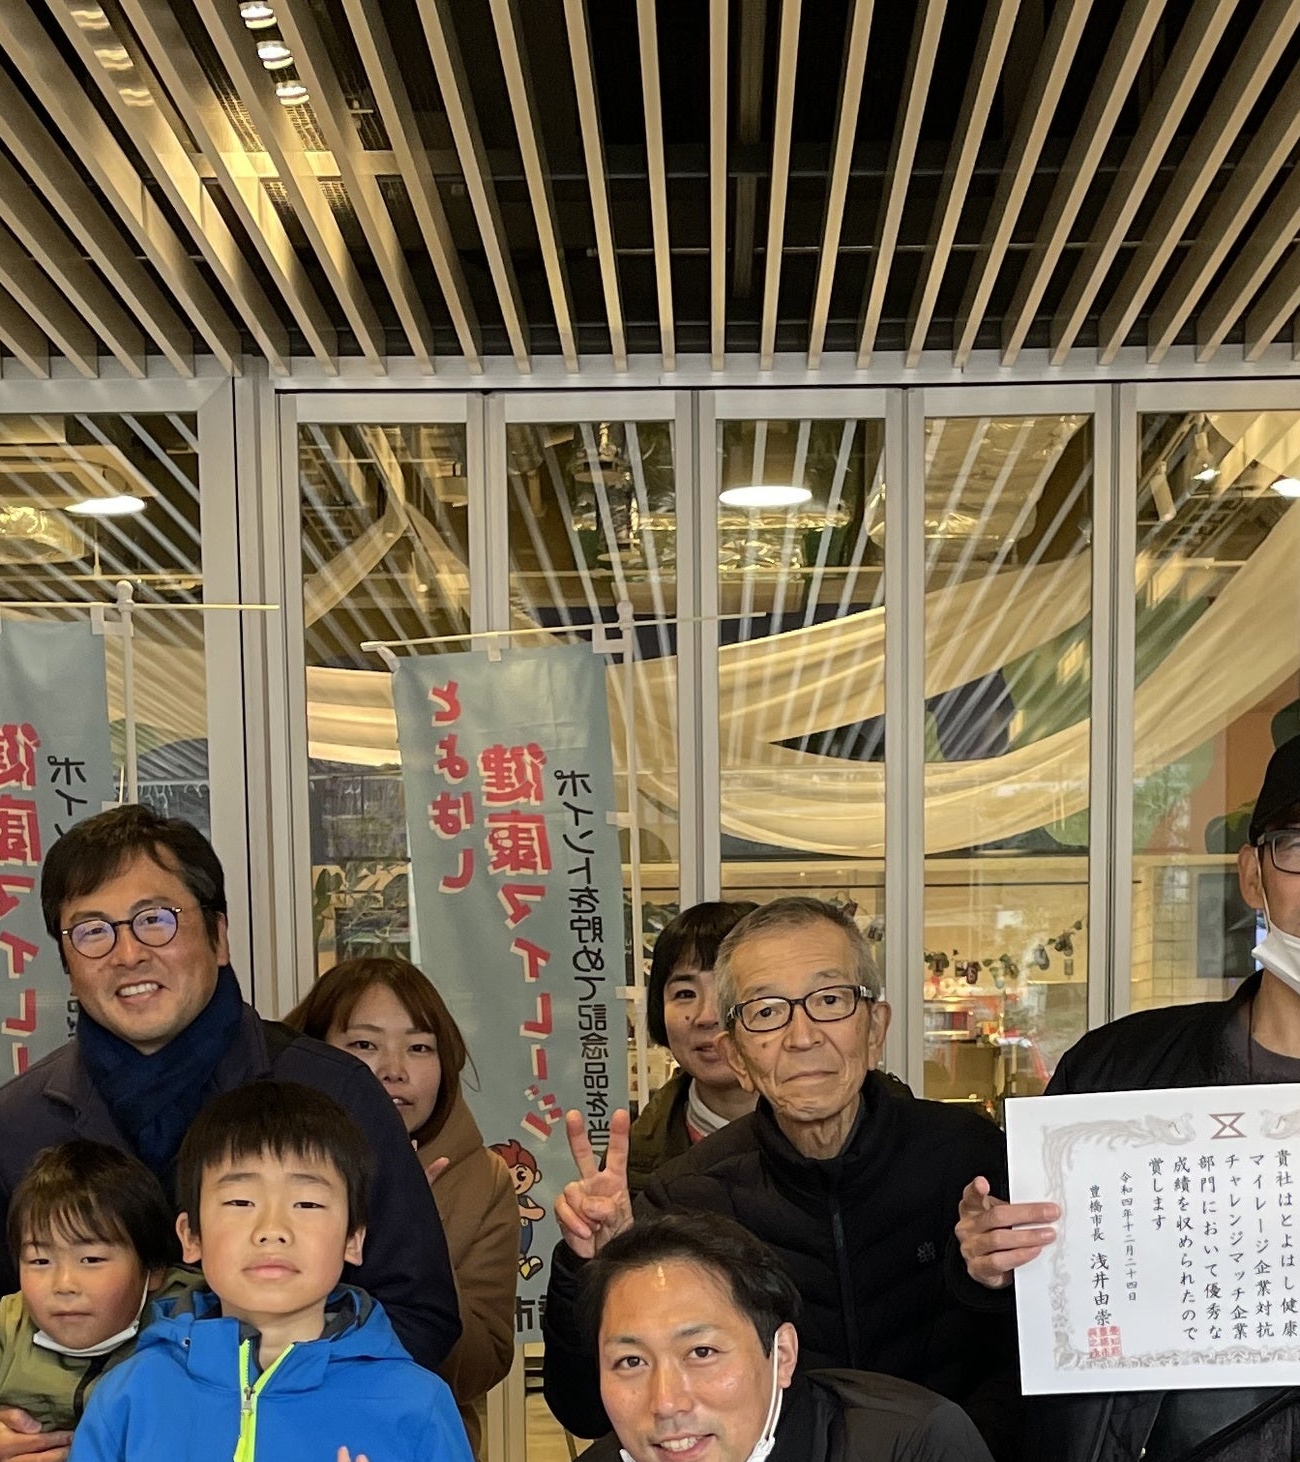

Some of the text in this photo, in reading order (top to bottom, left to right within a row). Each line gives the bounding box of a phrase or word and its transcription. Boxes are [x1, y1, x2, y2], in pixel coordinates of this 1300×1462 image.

[1089, 1184, 1105, 1242] 豊橋市長
[1120, 1171, 1138, 1301] 令和四年十二月二十四日
[1148, 1157, 1167, 1231] 賞します
[1173, 1156, 1198, 1341] 成績を収められたので
[1198, 1155, 1223, 1340] 部門において優秀な
[1224, 1153, 1249, 1340] チャレンジマッチ企業
[1249, 1154, 1275, 1338] マイレージ企業対抗
[1274, 1149, 1299, 1338] 貴社はとよはし健康
[1090, 1252, 1112, 1326] 浅井由崇
